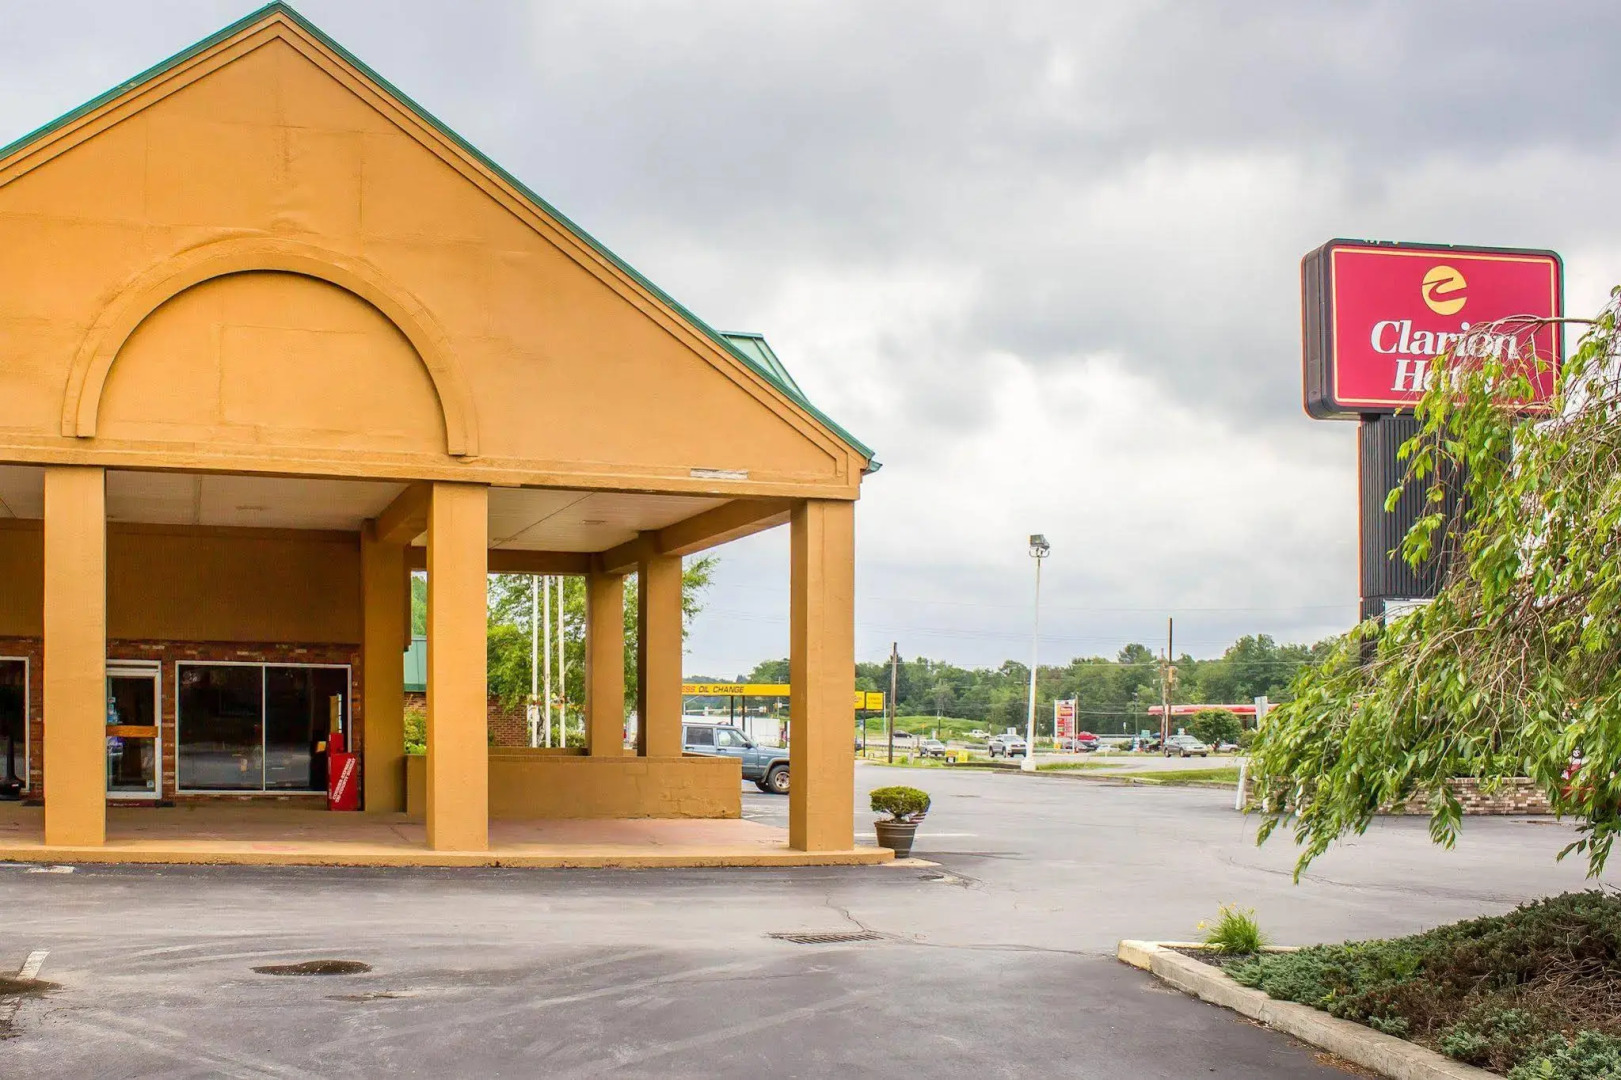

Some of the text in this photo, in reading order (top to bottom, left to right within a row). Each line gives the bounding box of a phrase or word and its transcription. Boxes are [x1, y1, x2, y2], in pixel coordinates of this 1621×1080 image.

[1370, 319, 1520, 360] Clarion
[698, 685, 709, 693] OIL
[712, 685, 745, 694] CHANGE
